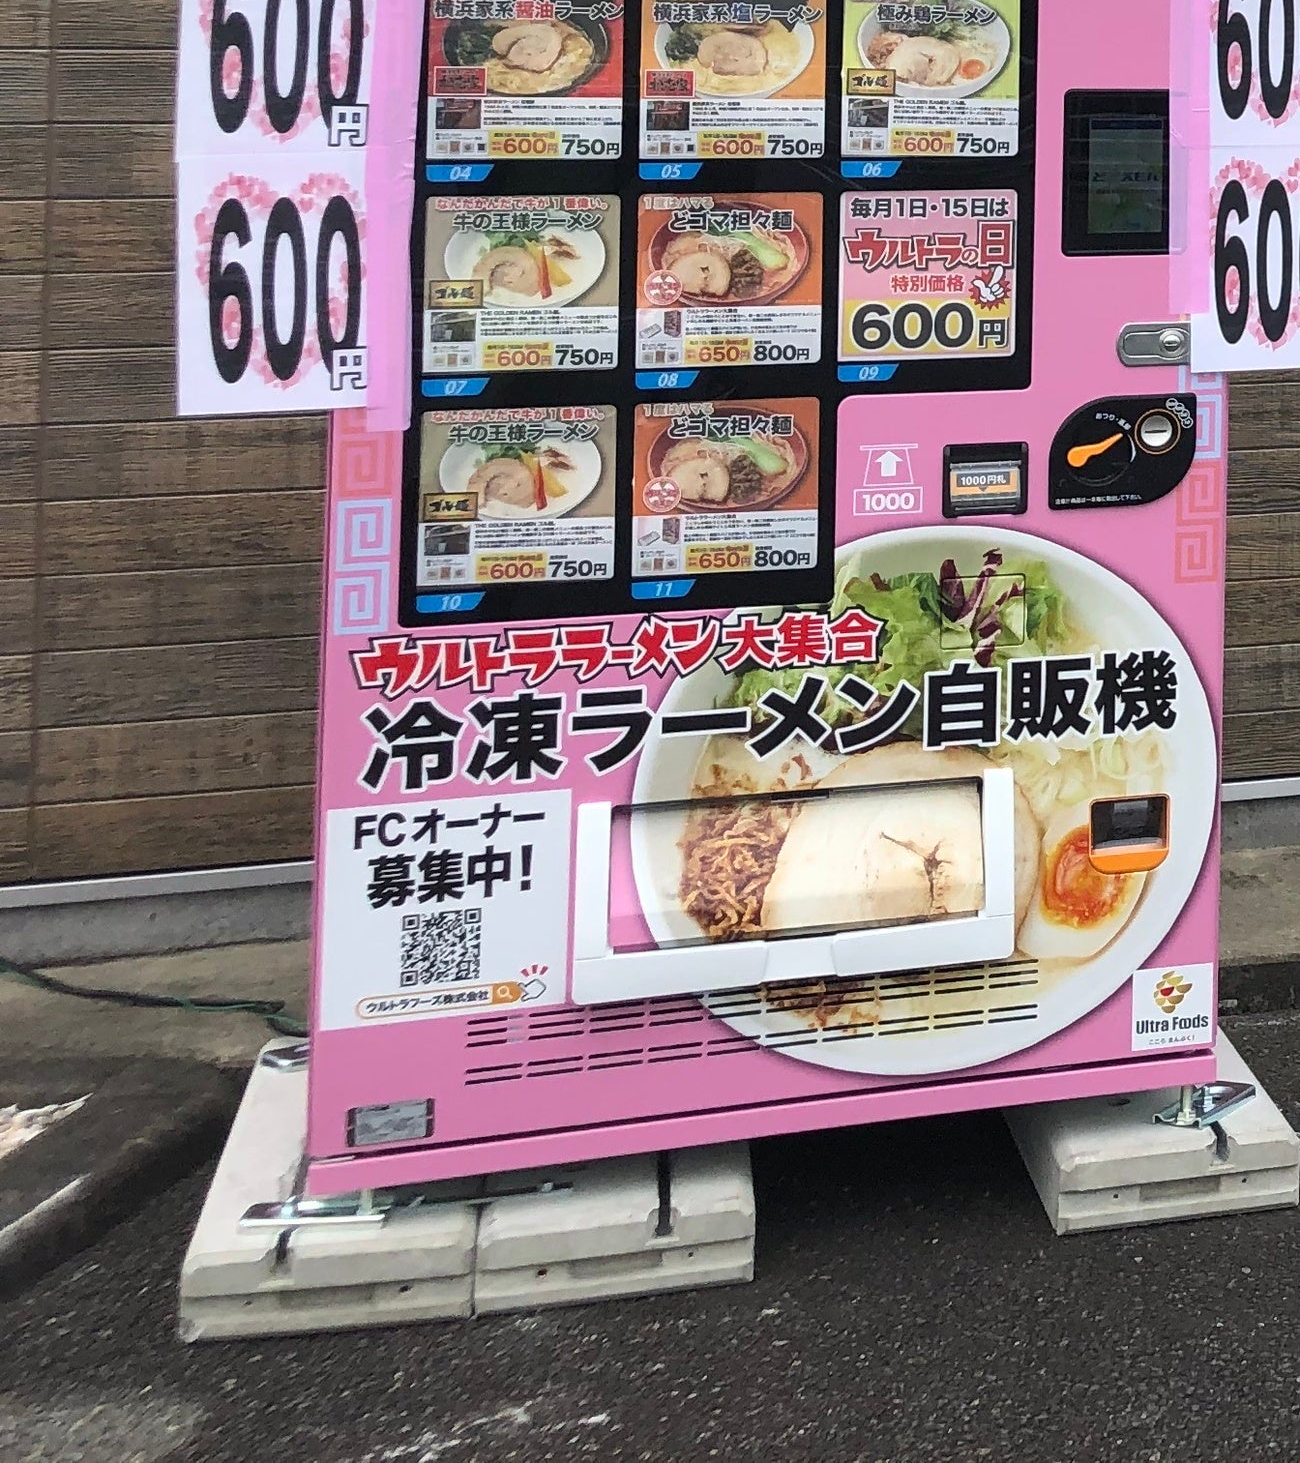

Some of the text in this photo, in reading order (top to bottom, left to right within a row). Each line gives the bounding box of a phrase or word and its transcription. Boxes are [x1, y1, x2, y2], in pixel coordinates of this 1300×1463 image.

[434, 0, 624, 20] 横浜家系醤油ラーメン
[876, 3, 997, 25] 極み鶏ラーメン
[562, 139, 619, 156] 750円
[768, 139, 822, 156] 750円
[957, 138, 1010, 154] 750円
[450, 165, 472, 180] 04
[661, 164, 682, 178] 05
[862, 163, 882, 177] 06
[850, 197, 1009, 219] 毎月1日・15日は
[453, 212, 603, 232] 牛の王様ラーメン
[668, 210, 795, 232] どゴマ担々麺
[843, 220, 1015, 272] ウルトラの日
[208, 196, 367, 390] 600円
[891, 275, 965, 293] 特別価格
[852, 302, 1009, 350] 600円
[555, 349, 614, 366] 750円
[753, 344, 809, 361] 800円
[658, 373, 679, 387] 08
[858, 366, 879, 380] 09
[445, 381, 468, 395] 07
[449, 423, 598, 444] 牛の王様ラーメン
[668, 414, 794, 438] どゴマ担々麺
[960, 474, 1007, 486] 1000円札
[863, 493, 915, 511] 1000
[754, 550, 811, 568] 800円
[549, 560, 607, 578] 750円
[655, 583, 673, 597] 11
[441, 596, 462, 610] 10
[351, 607, 888, 698] ウルトララーメン大集合
[358, 649, 1179, 792] 冷凍ラーメン自販機
[366, 990, 489, 1013] ウルトラフーズ株式会社
[1136, 1014, 1209, 1035] Ultra Foods
